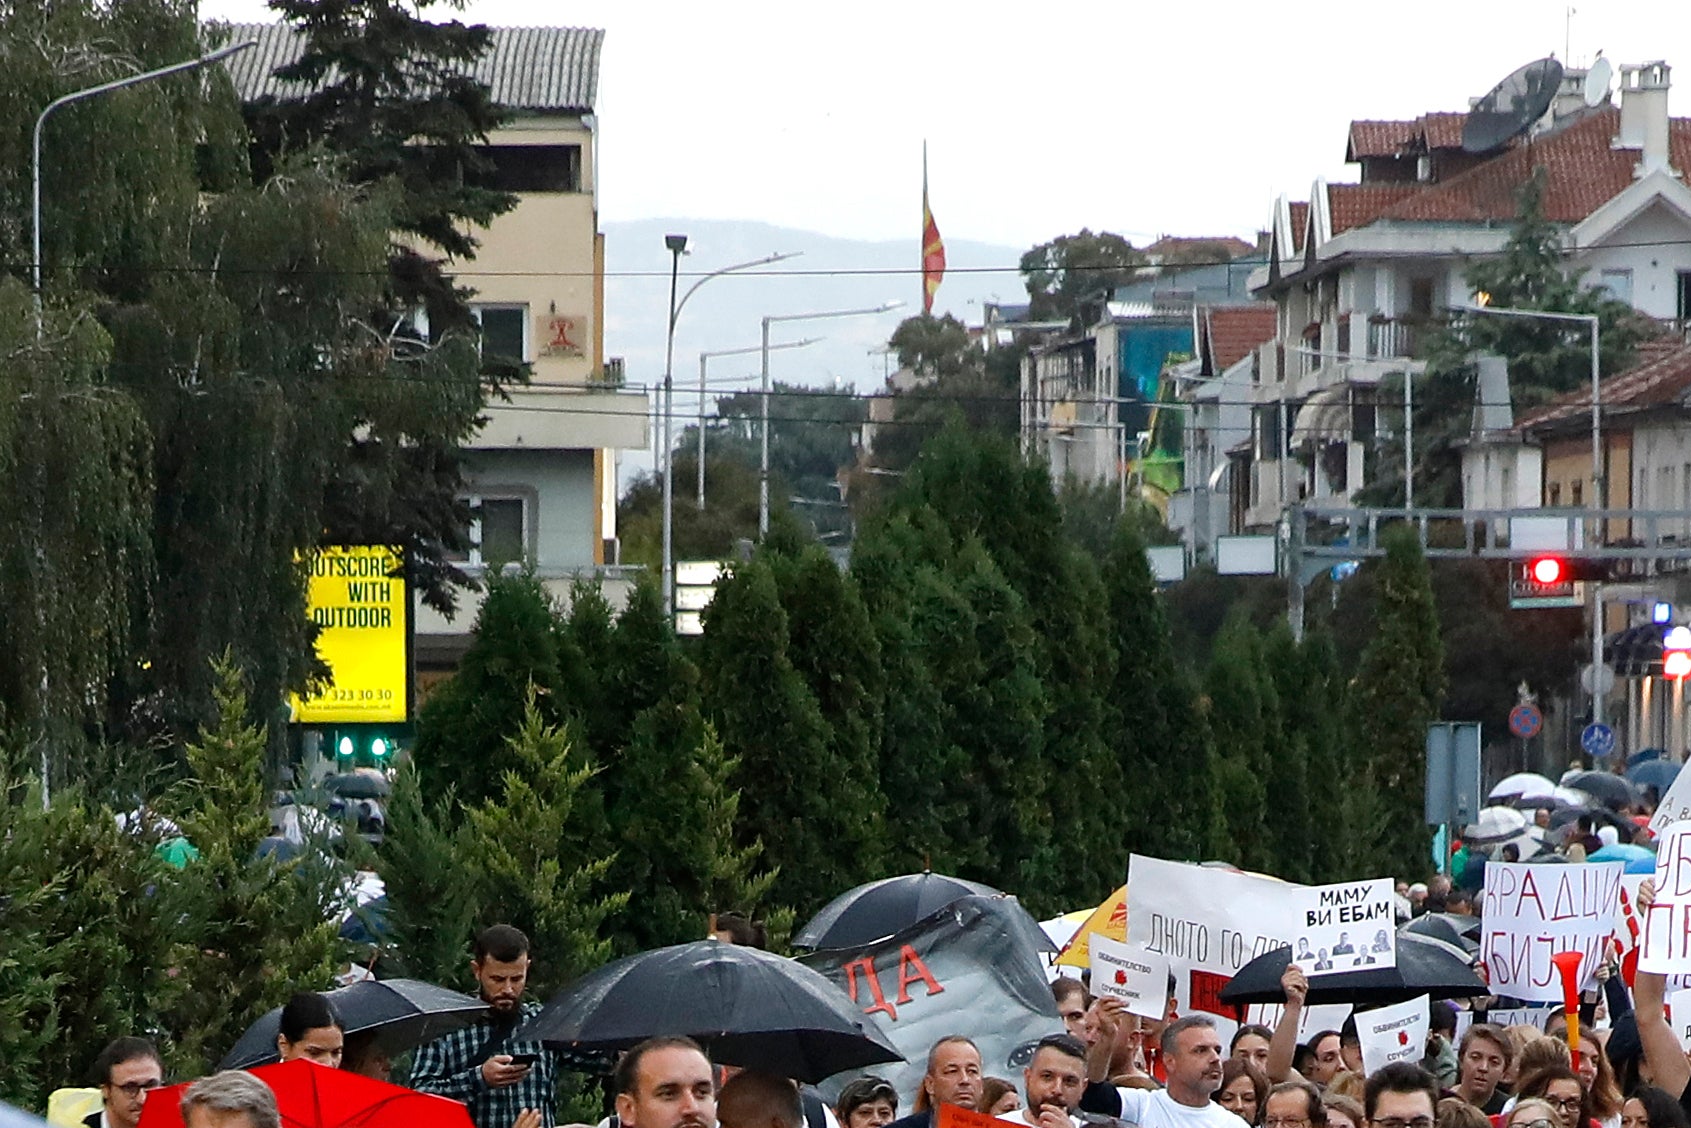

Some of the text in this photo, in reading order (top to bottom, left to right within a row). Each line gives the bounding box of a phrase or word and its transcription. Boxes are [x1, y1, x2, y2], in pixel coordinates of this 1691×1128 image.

[348, 581, 391, 602] WITH
[313, 607, 391, 628] OUTDOOR
[331, 689, 354, 701] 323
[358, 689, 373, 701] 30
[377, 689, 392, 701] 30
[1320, 885, 1373, 907] МАМУ
[1485, 867, 1622, 921] КРАДЦИ
[1306, 901, 1389, 927] ВИ ЕБАМ
[1145, 913, 1209, 963] ДНОТО
[1220, 928, 1243, 970] ГО
